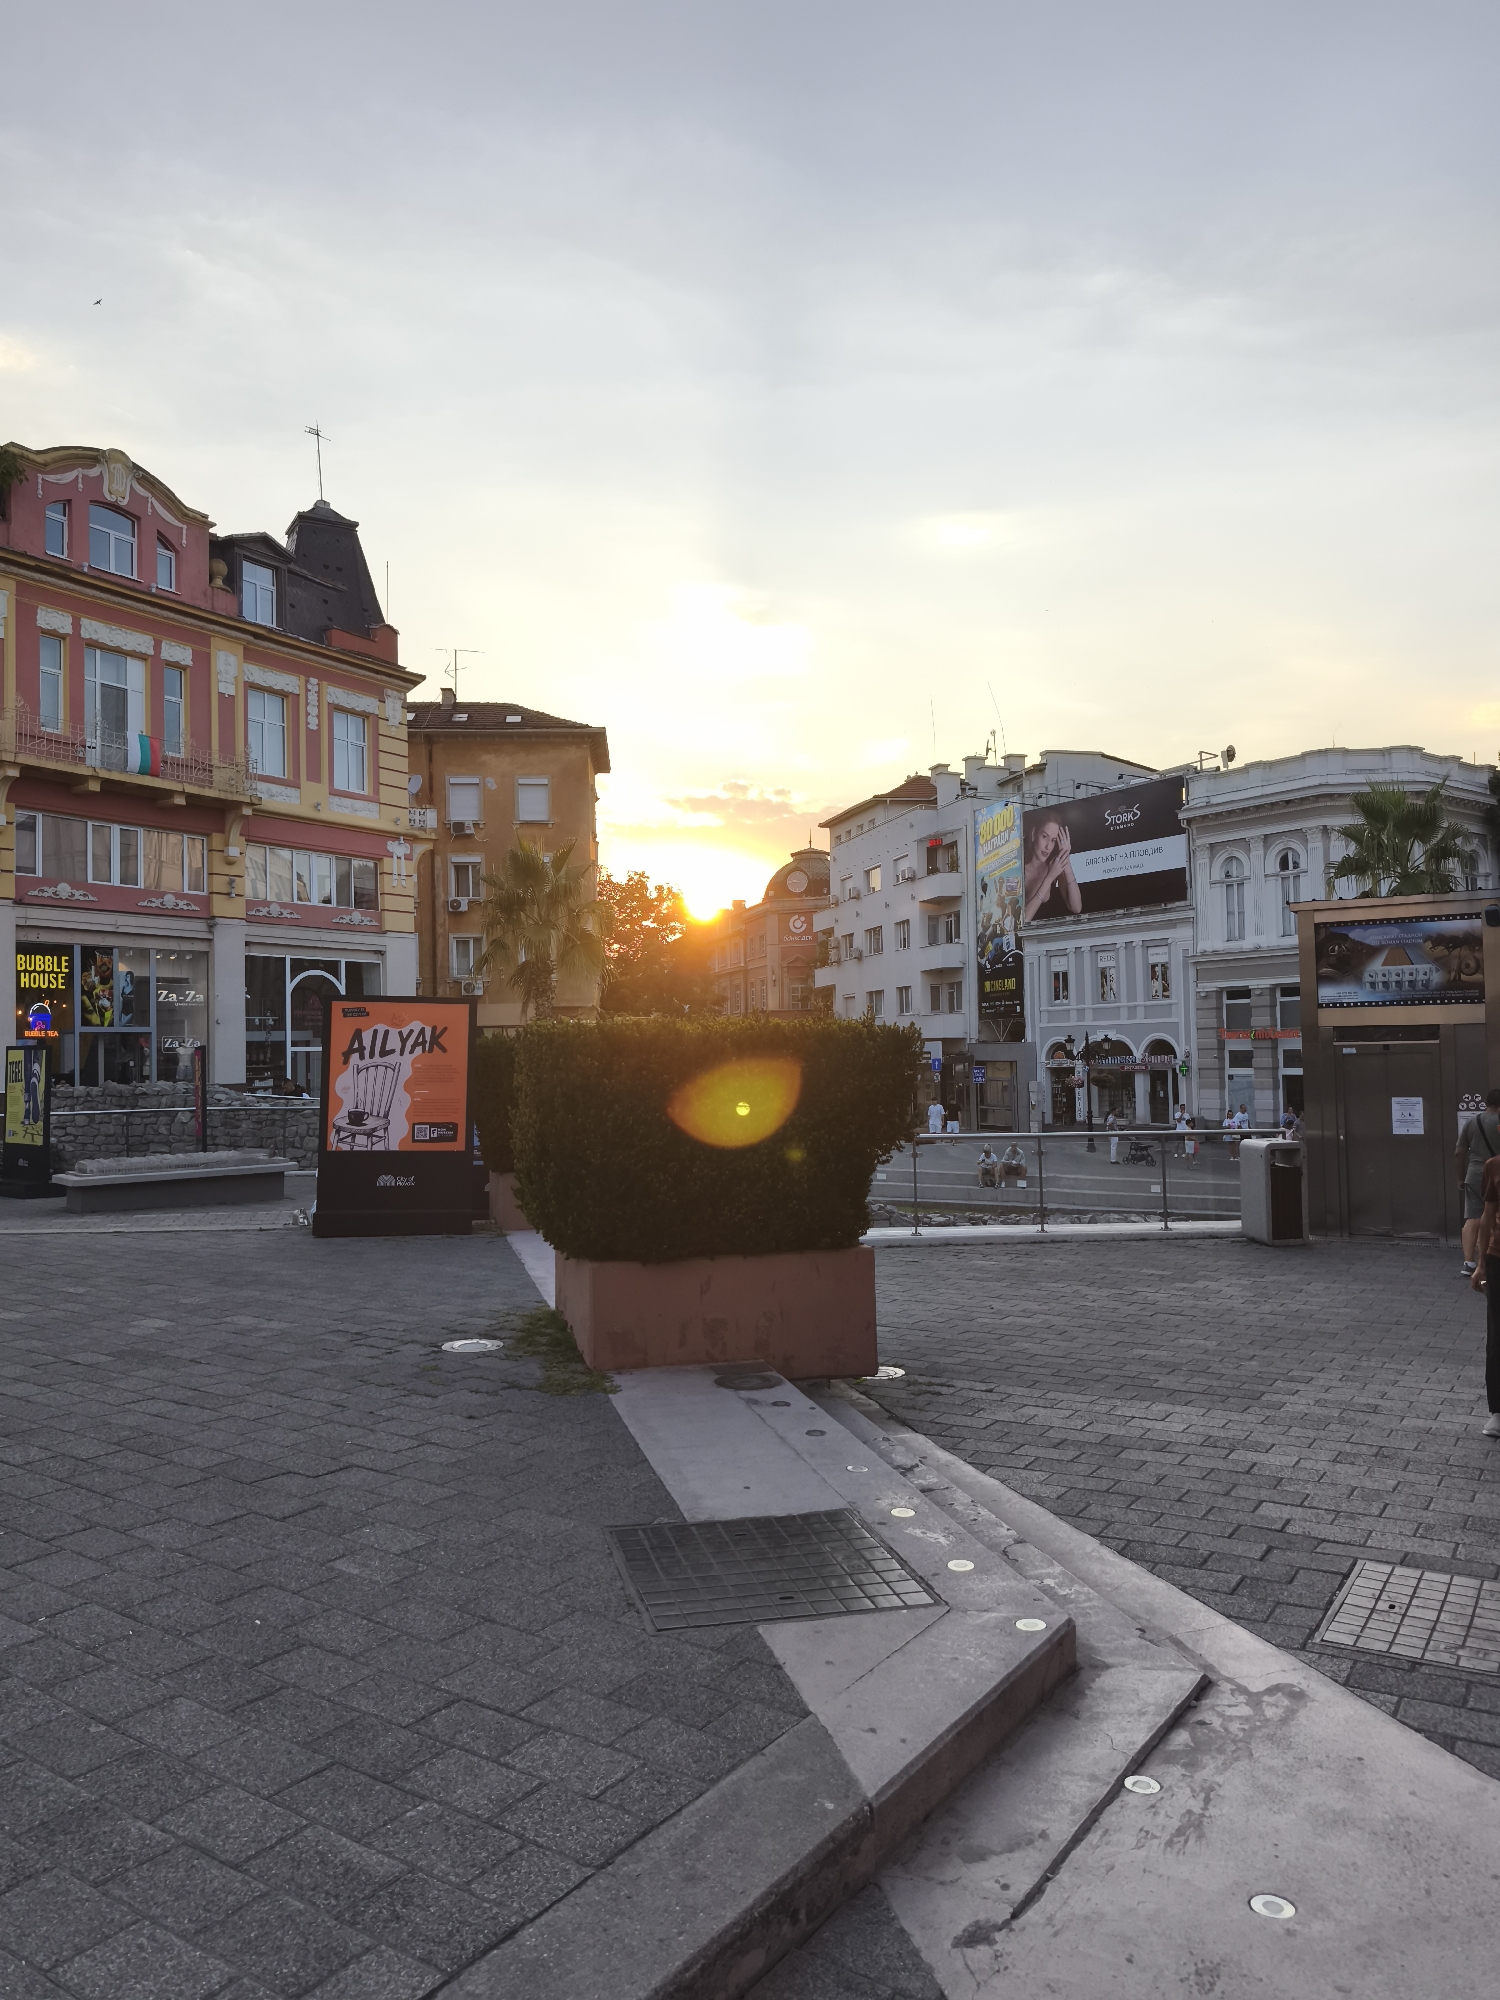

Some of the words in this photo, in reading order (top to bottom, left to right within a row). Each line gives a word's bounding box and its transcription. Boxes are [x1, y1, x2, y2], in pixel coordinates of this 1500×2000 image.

[1104, 803, 1141, 826] STORKS
[1129, 846, 1164, 859] ПЛОВДИВ
[17, 954, 69, 973] BUBBLE
[20, 972, 66, 989] HOUSE
[157, 989, 204, 1002] Za-Za
[342, 1024, 449, 1066] AILYAK
